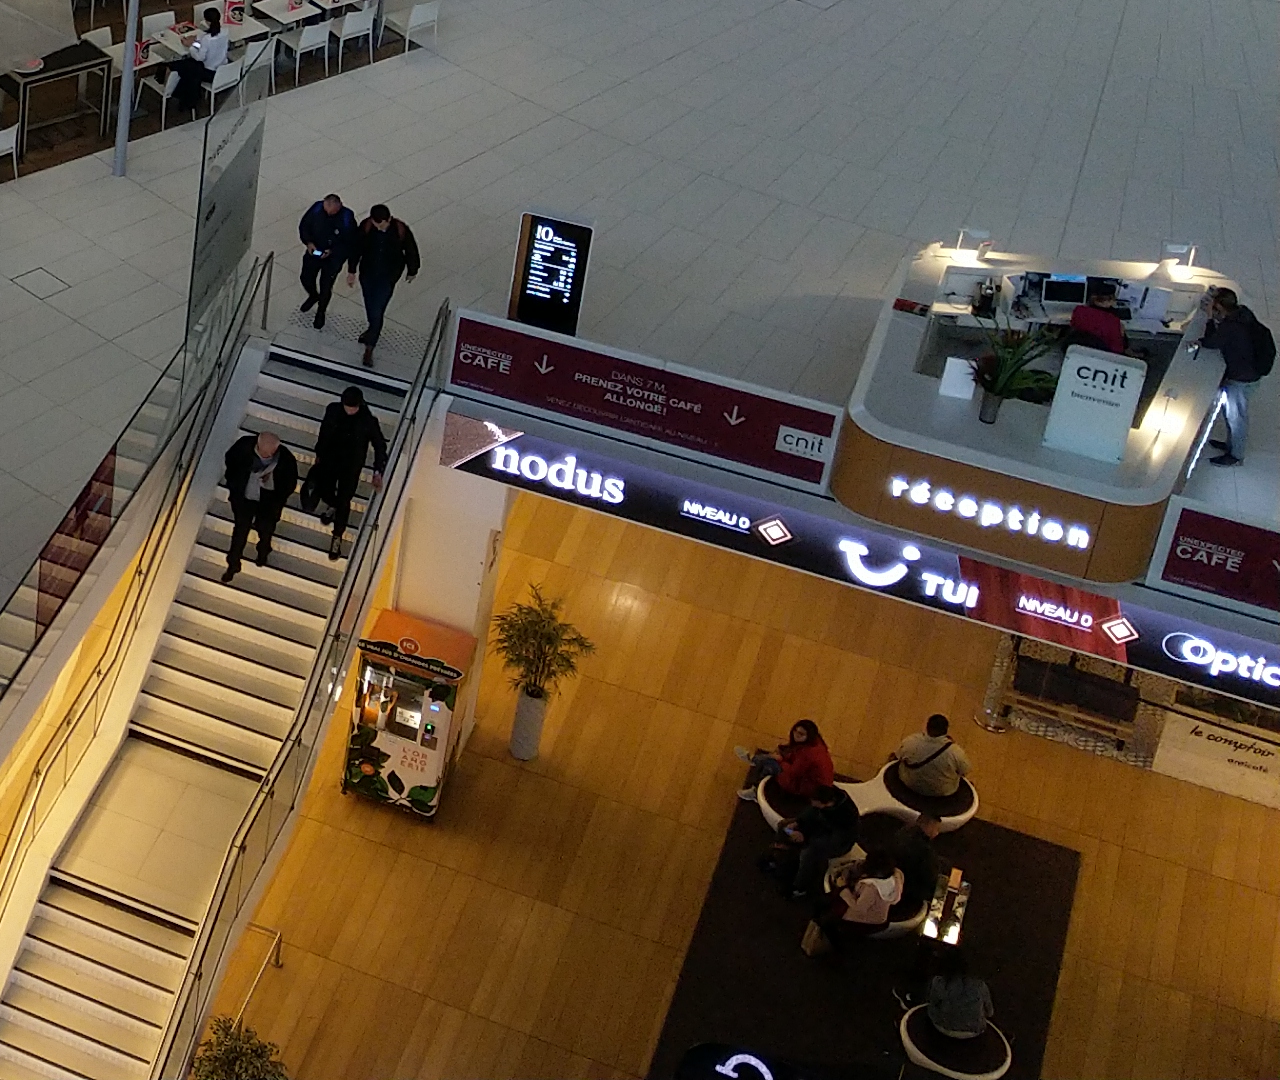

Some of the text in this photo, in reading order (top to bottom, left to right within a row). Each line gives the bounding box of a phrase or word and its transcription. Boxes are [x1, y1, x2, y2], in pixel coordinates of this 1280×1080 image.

[460, 342, 513, 361] UNEXPECTED
[611, 370, 644, 387] DANS
[1076, 366, 1128, 388] cnit
[574, 372, 702, 414] PRENEZ VOTRE CAFÉ
[783, 433, 824, 453] cnit
[491, 445, 626, 505] nodus
[683, 500, 738, 526] NIVEAU
[890, 476, 1090, 550] réception
[1178, 535, 1245, 558] UNEXPECTED
[921, 572, 980, 608] TUI
[1019, 596, 1079, 623] NIVEAU
[1181, 638, 1280, 687] Optic
[1189, 725, 1274, 758] le comptoir
